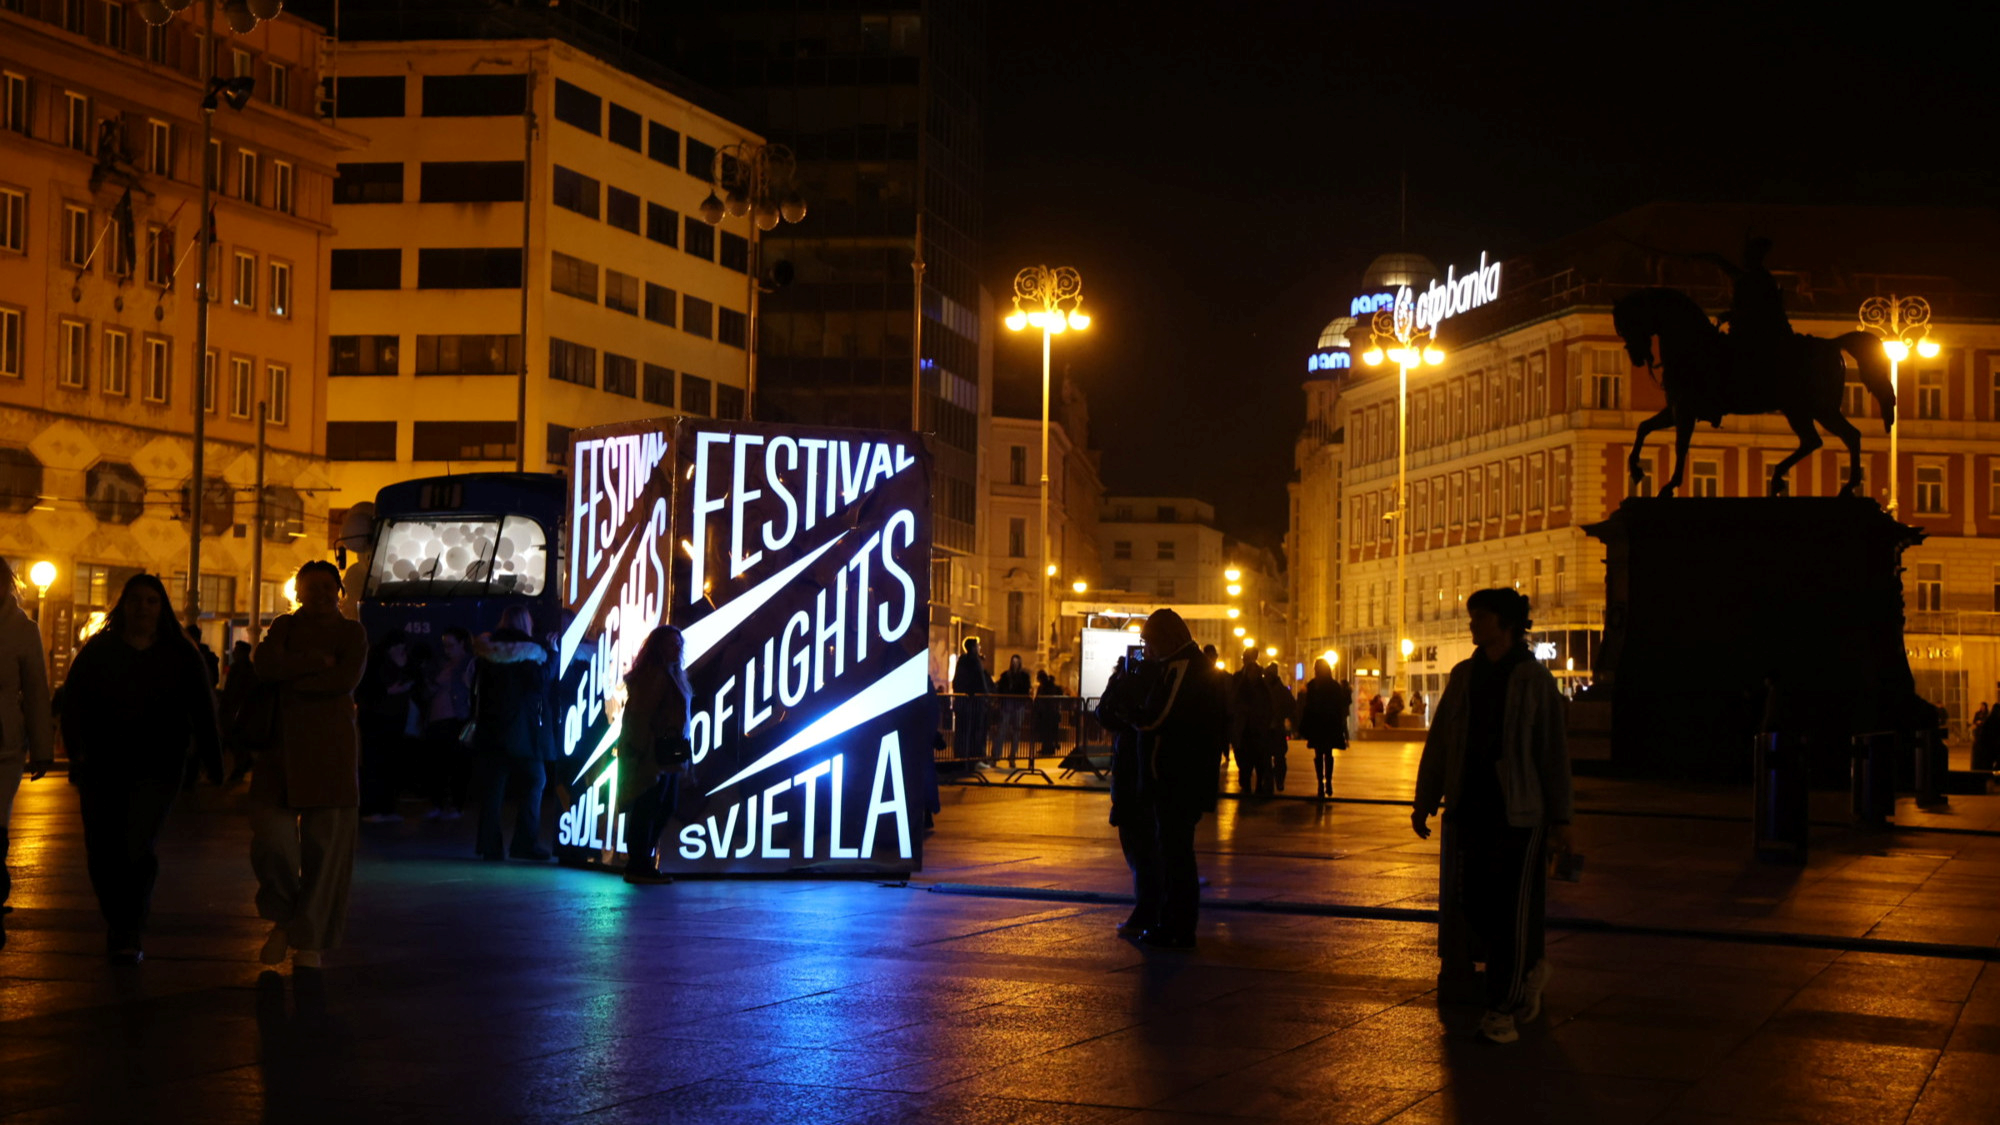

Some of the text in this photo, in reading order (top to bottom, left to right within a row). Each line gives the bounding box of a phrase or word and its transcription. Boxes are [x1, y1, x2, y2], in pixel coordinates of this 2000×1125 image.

[1351, 293, 1413, 318] nam
[569, 431, 667, 605] FESTIVAL
[690, 431, 914, 605] FESTIVAL
[404, 621, 431, 634] 453
[690, 509, 916, 764] OF LIGHTS
[564, 670, 589, 756] OF
[559, 757, 650, 856] SVJETL
[679, 730, 912, 860] SVJETLA
